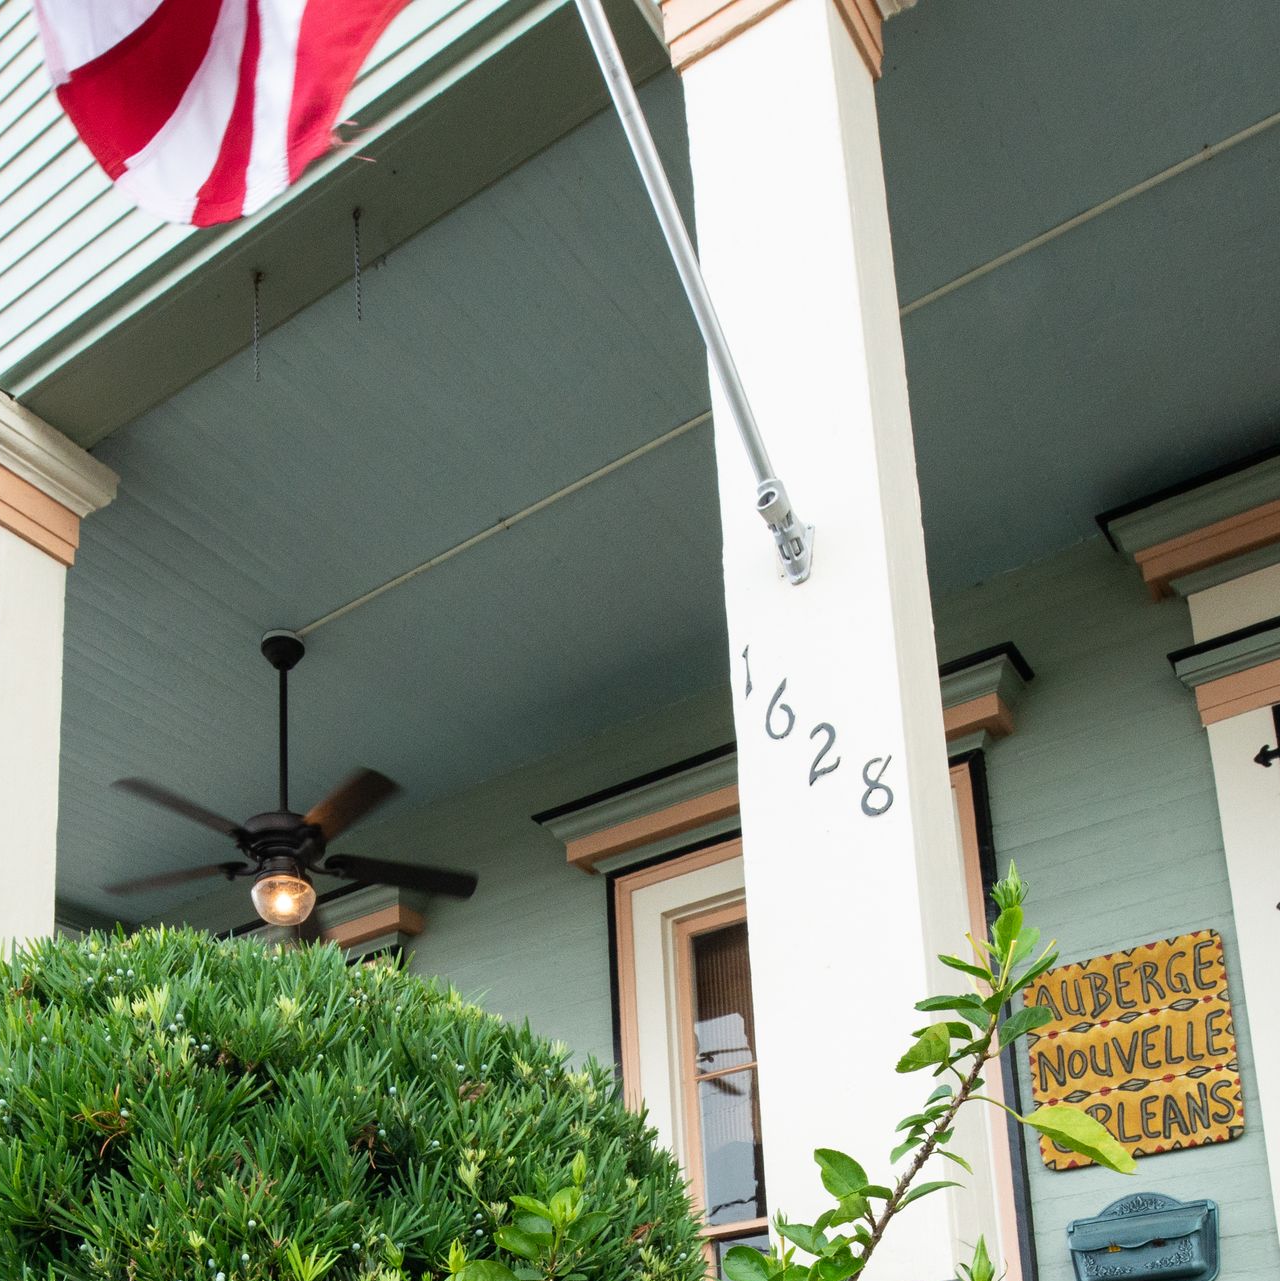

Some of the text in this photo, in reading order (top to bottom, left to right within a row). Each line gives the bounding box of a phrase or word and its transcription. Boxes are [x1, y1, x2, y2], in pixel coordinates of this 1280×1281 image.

[741, 644, 895, 817] 1628
[1035, 939, 1218, 1021] AUBERGE
[1037, 1008, 1229, 1093] NOUVELLE
[1051, 1079, 1236, 1153] RLEANS
